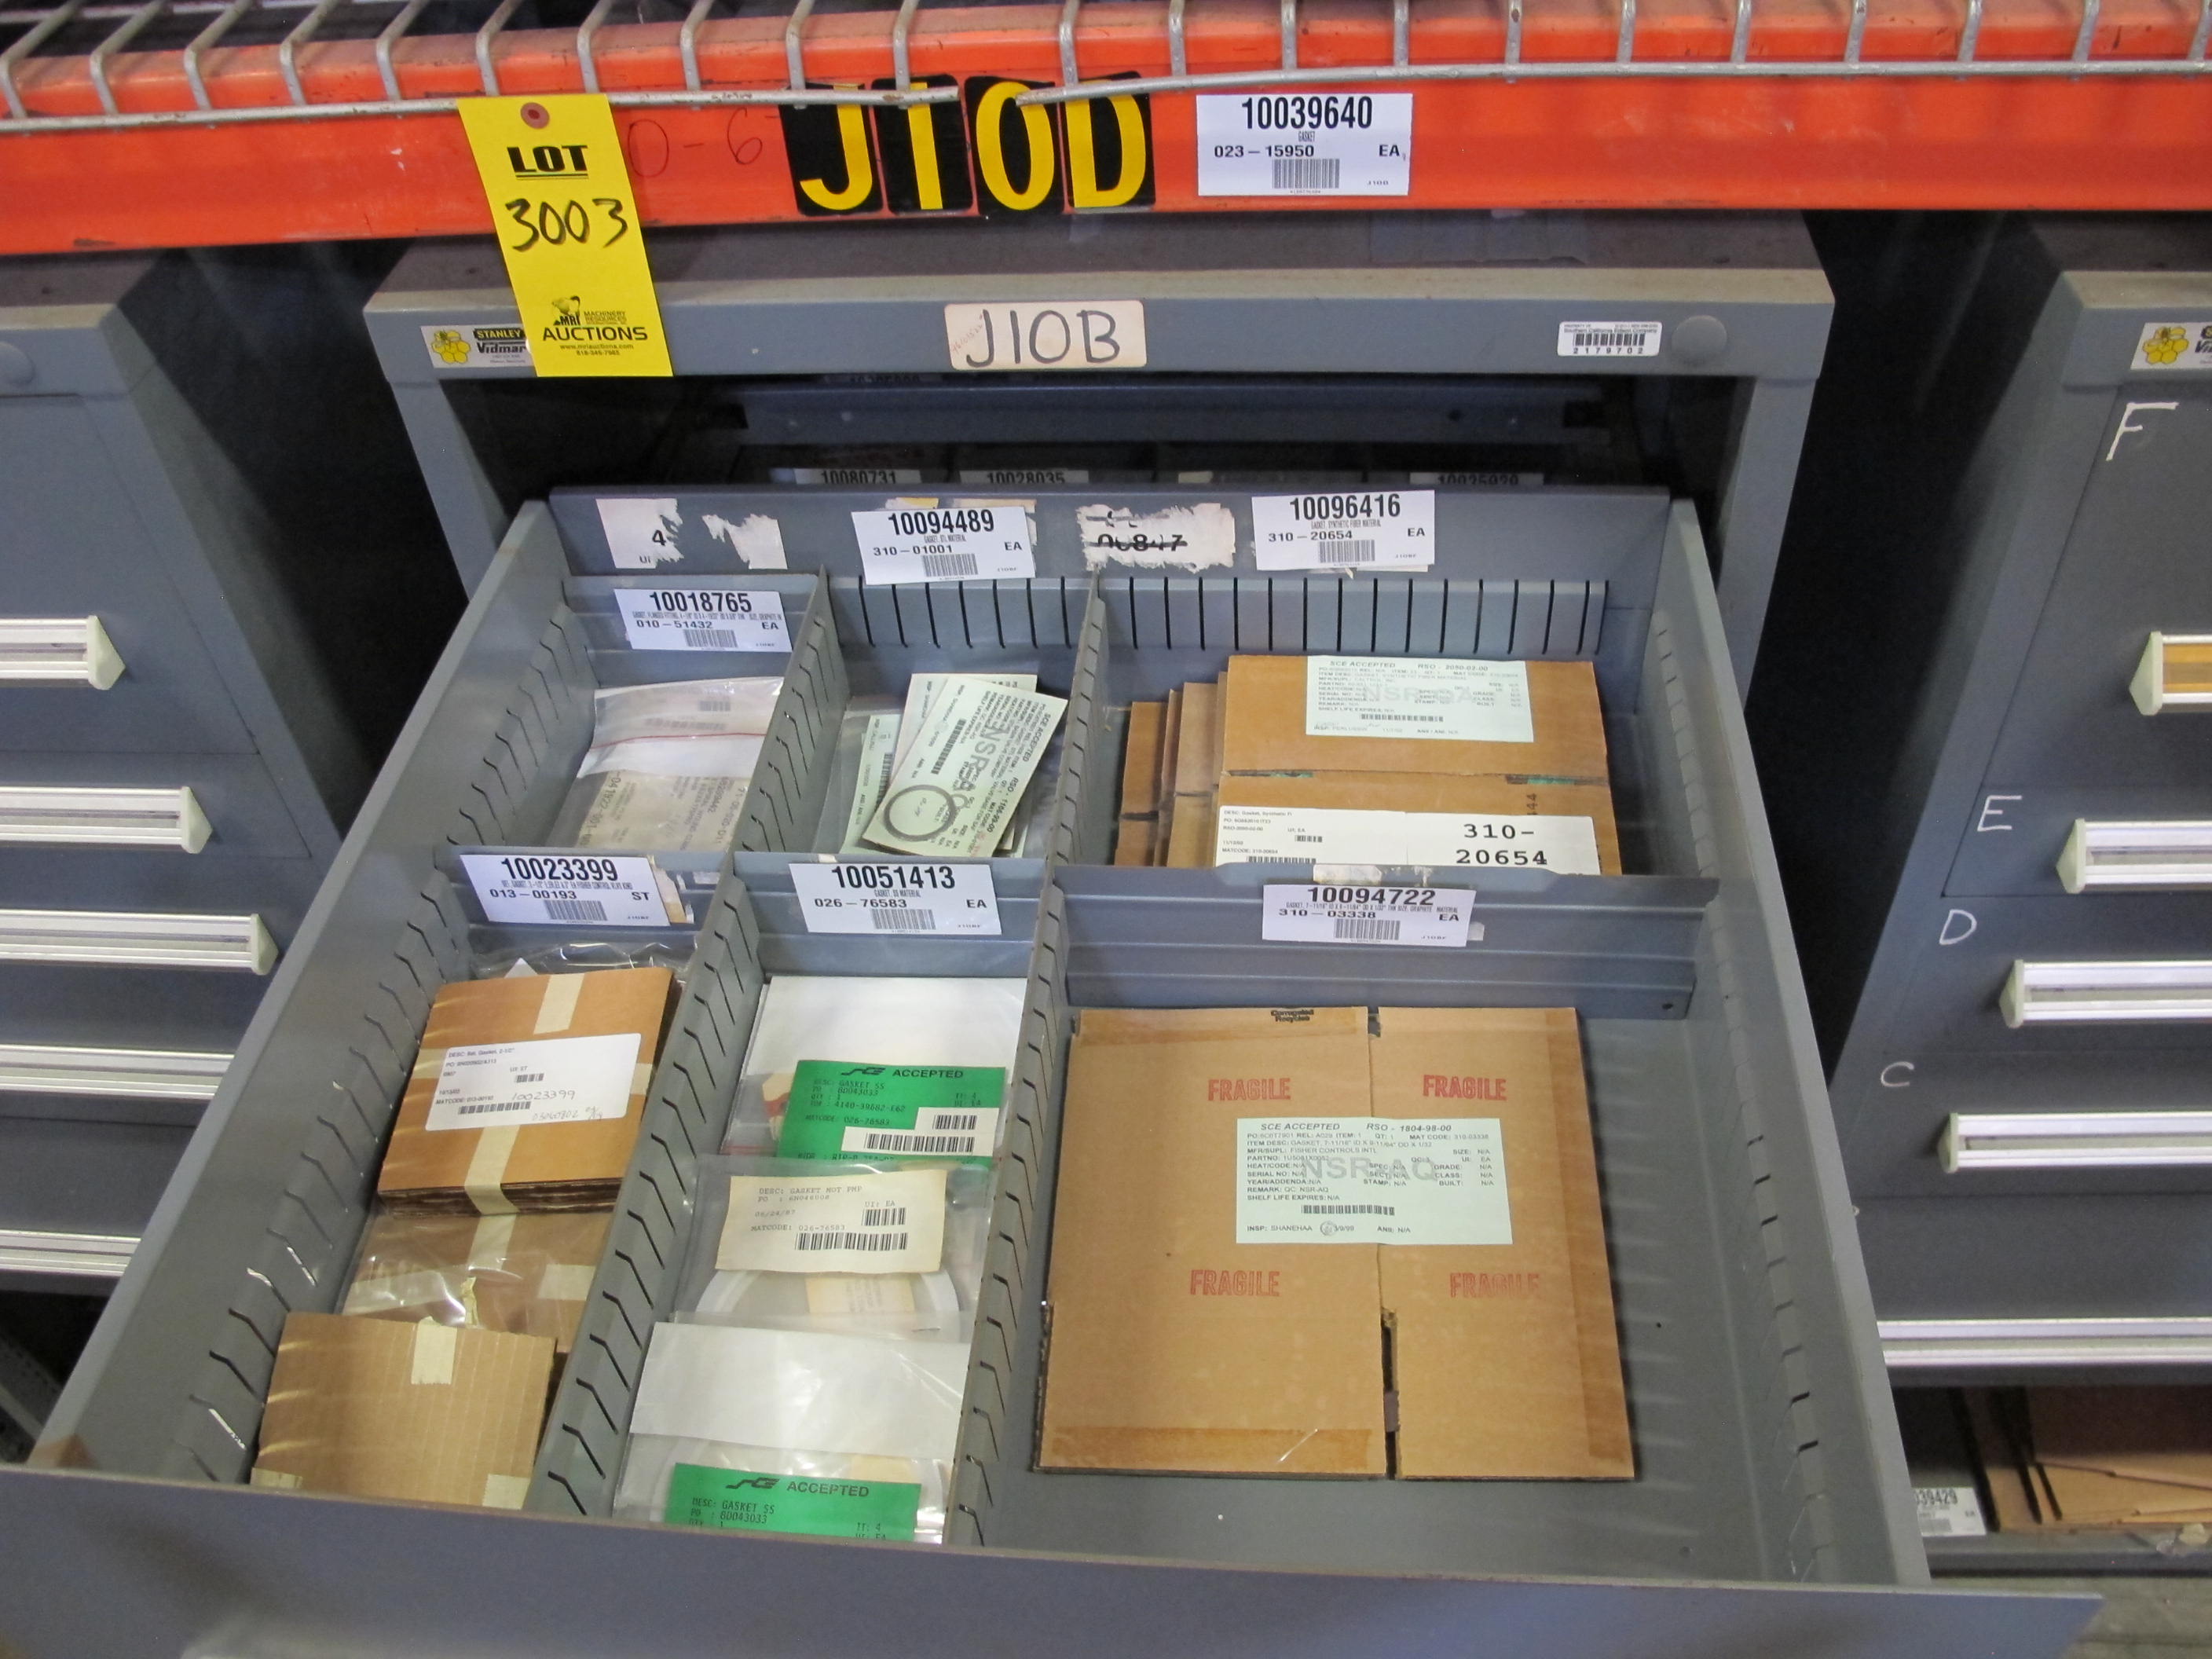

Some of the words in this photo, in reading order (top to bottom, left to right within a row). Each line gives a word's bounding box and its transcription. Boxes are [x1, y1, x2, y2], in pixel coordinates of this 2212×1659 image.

[1242, 96, 1373, 130] 10039640
[507, 145, 588, 174] LOT
[1214, 145, 1245, 158] 023
[1265, 145, 1314, 158] 15950
[1379, 144, 1400, 157] EA
[504, 197, 628, 251] 3003
[475, 328, 522, 340] STANLEY
[543, 327, 648, 342] AUCTIONS
[477, 342, 527, 353] Vidmar
[2105, 401, 2178, 462] F
[1289, 493, 1401, 521] 10096416
[888, 509, 995, 536] 10094489
[1268, 533, 1295, 543] 310
[1310, 530, 1353, 541] 20654
[1407, 528, 1426, 538] EA
[873, 546, 898, 557] 310
[912, 544, 954, 555] 01001
[1004, 541, 1023, 551] EA
[650, 591, 753, 613] 10018765
[636, 620, 661, 629] 010
[674, 620, 713, 629] 51432
[761, 621, 779, 630] EA
[1977, 796, 2022, 833] E
[1463, 823, 1535, 840] 310-
[1455, 848, 1548, 866] 20654
[501, 857, 618, 881] 10023399
[831, 865, 956, 889] 10051413
[489, 888, 516, 899] 013
[533, 889, 577, 900] 00193
[632, 892, 650, 901] ST
[815, 898, 843, 908] 026
[859, 898, 907, 908] 76583
[966, 899, 987, 909] EA
[1307, 886, 1436, 906] 10094722
[1328, 910, 1376, 918] 03338
[1439, 913, 1459, 921] EA
[1939, 909, 1977, 945] D
[892, 1069, 965, 1079] ACCEPTED
[1881, 1060, 1914, 1086] C
[1208, 1078, 1291, 1101] FRAGILE
[1422, 1074, 1507, 1100] FRAGILE
[1366, 1122, 1389, 1131] RSO
[751, 1224, 793, 1232] MATCODE:
[1190, 1269, 1280, 1297] FRAGILE
[1450, 1272, 1540, 1299] FRAGILE
[786, 1481, 870, 1498] ACCEPTED
[722, 1500, 757, 1513] GASKET
[763, 1503, 775, 1514] SS
